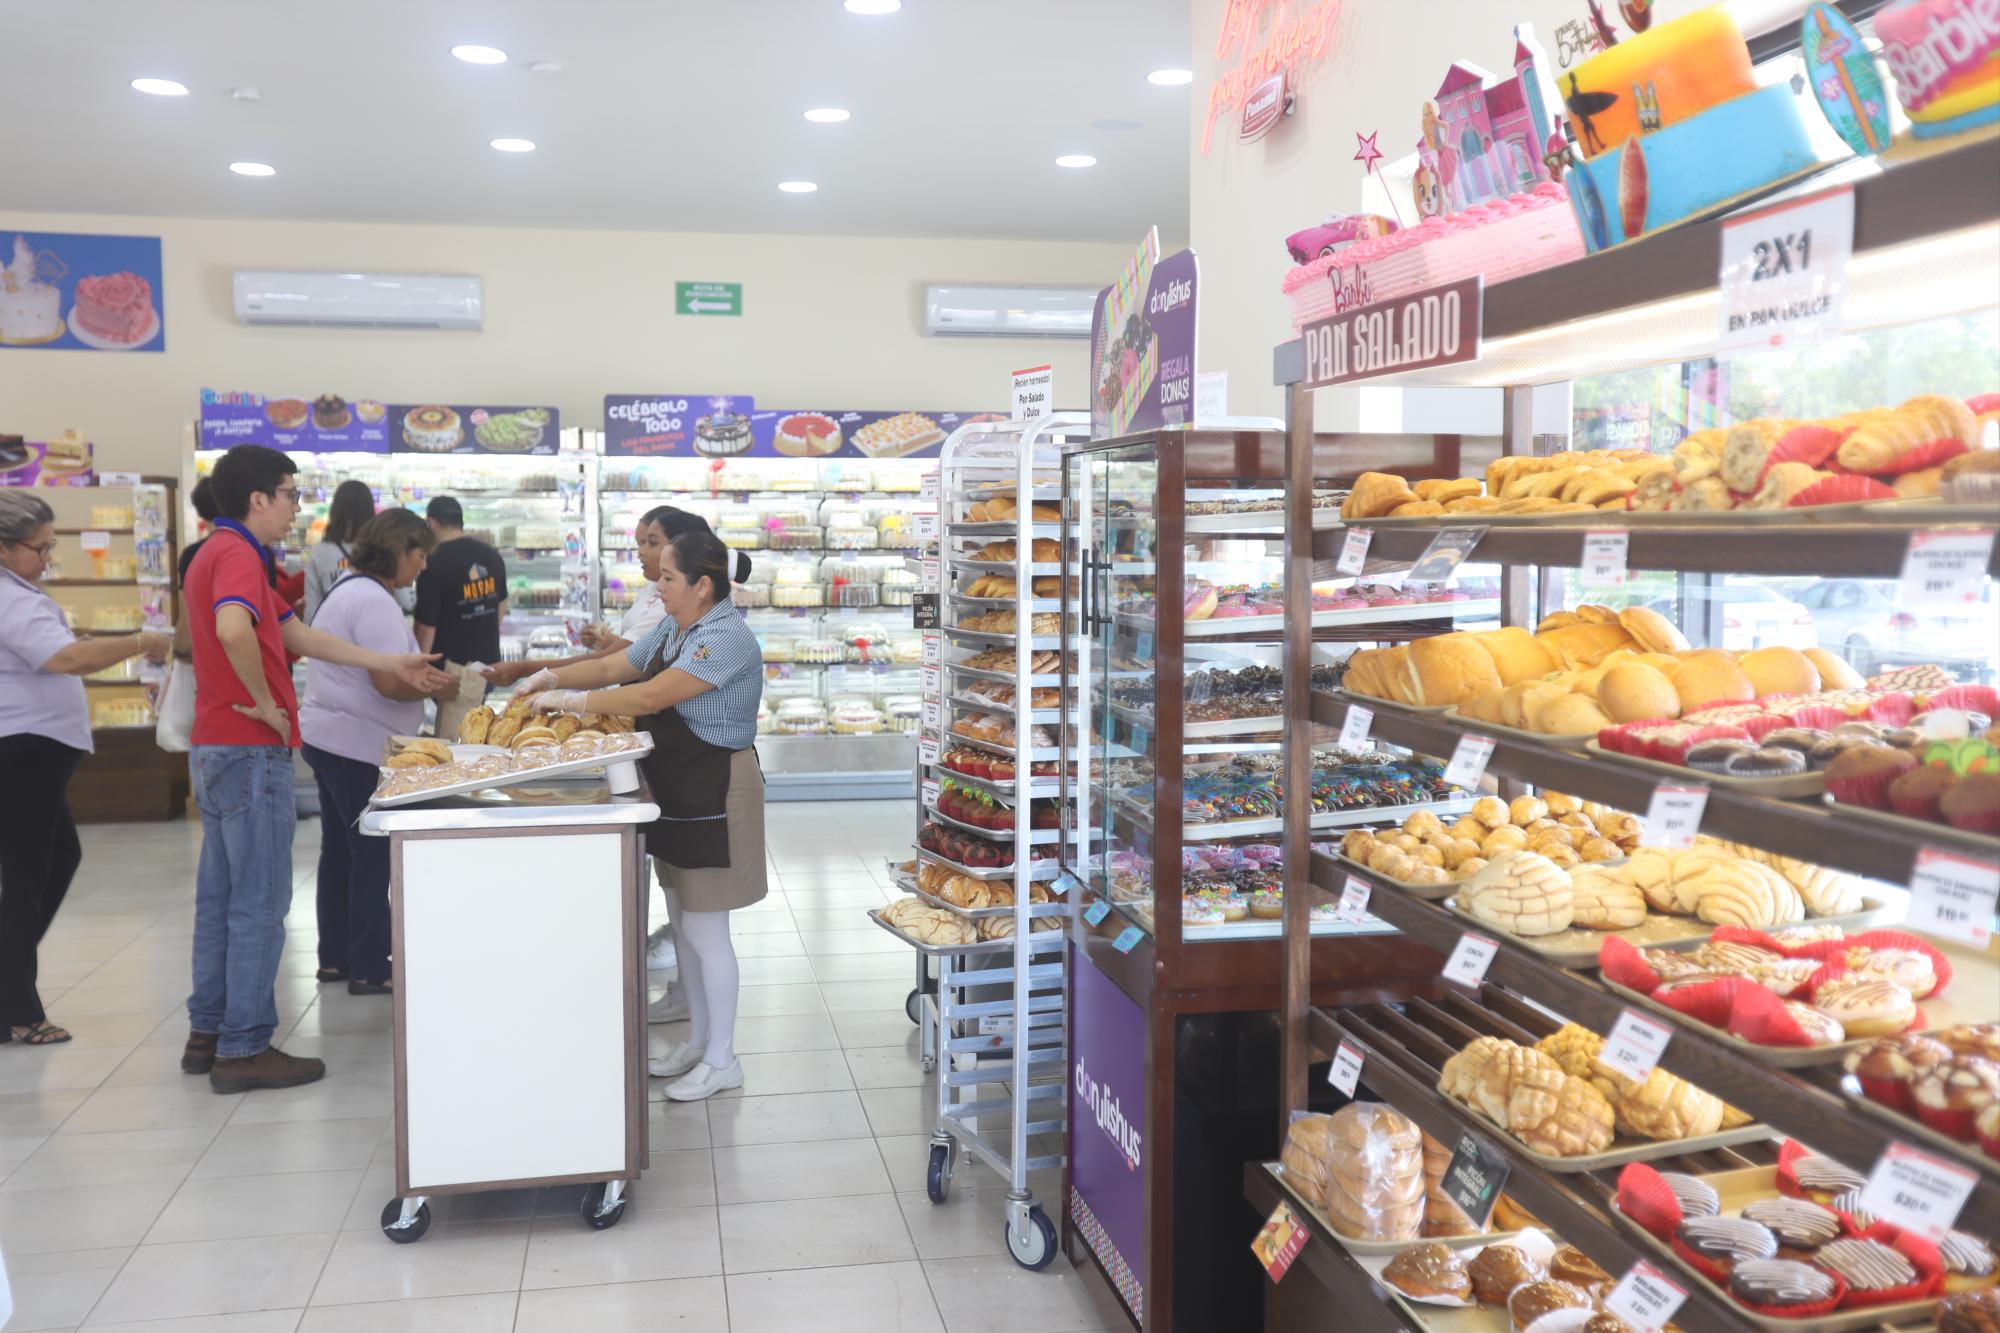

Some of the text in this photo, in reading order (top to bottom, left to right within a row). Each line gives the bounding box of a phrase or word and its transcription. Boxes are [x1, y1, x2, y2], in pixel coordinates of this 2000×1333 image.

[1753, 228, 1812, 282] 2X1
[1729, 315, 1745, 332] EN
[1751, 306, 1777, 325] PAN
[1305, 290, 1461, 384] PAN SALADO
[1019, 391, 1045, 404] Pan Salado
[1161, 376, 1189, 403] DONAS!
[641, 417, 681, 434] TODO
[1027, 407, 1040, 418] Dulce
[1454, 1166, 1480, 1199] INTEGRAL
[1468, 1165, 1487, 1188] PICÓN
